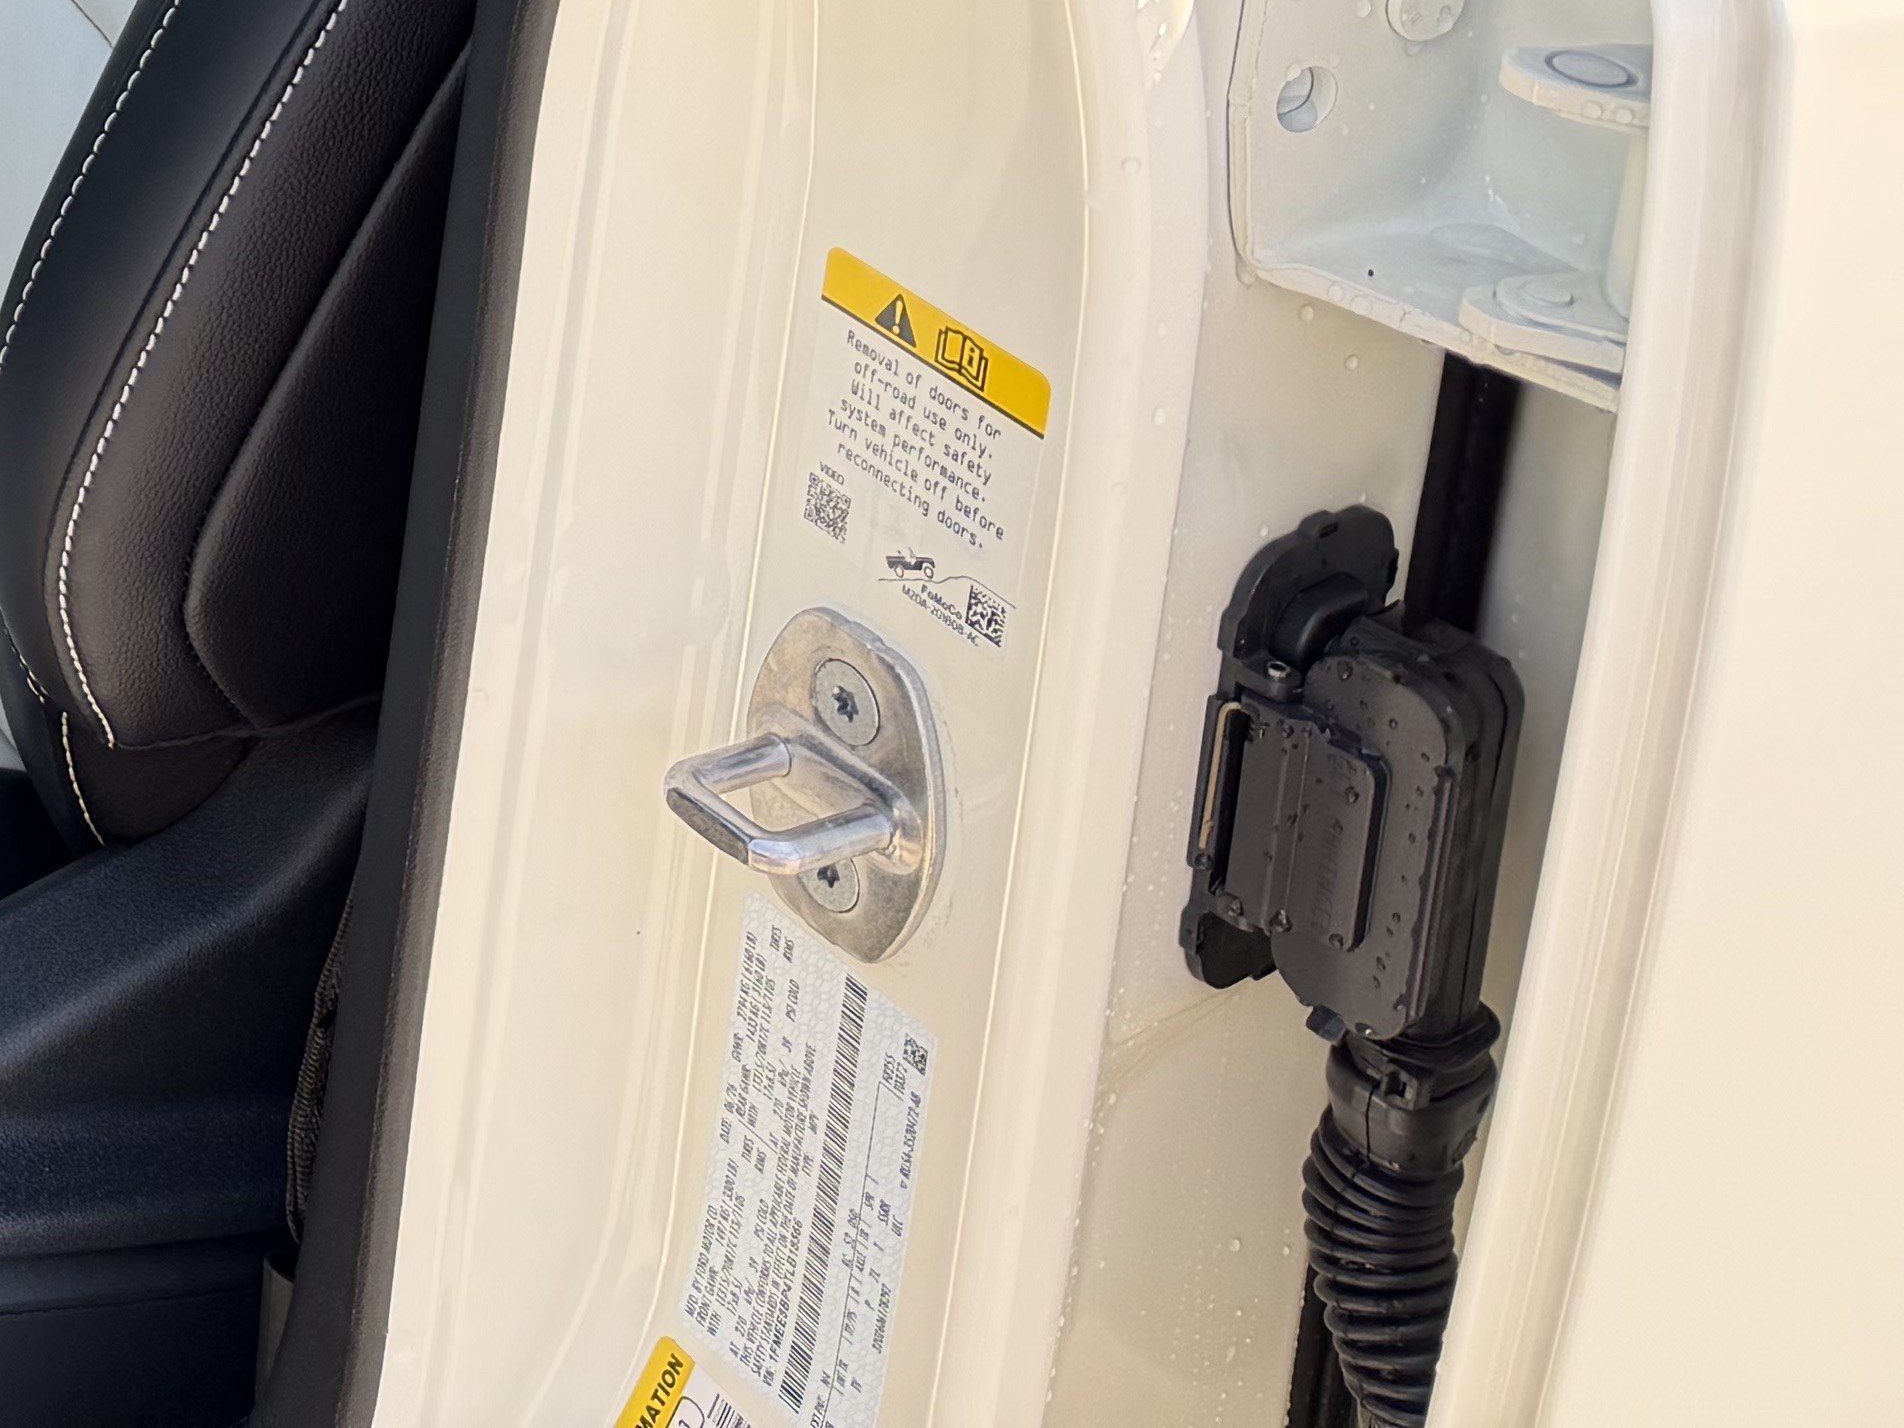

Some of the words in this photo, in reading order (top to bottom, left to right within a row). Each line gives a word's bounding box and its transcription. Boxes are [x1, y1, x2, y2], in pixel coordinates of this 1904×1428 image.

[847, 329, 899, 377] Removal
[906, 371, 922, 389] of
[929, 385, 969, 421] doors
[978, 415, 1002, 440] for
[851, 378, 881, 411] Will
[889, 408, 936, 446] affect
[943, 443, 992, 486] safety
[854, 361, 916, 410] off-road
[923, 406, 947, 431] use
[954, 427, 993, 459] only.
[819, 461, 845, 485] VIDEO
[828, 408, 857, 441] Turn
[865, 437, 919, 483] vehicle
[924, 478, 948, 500] off
[955, 495, 1004, 541] before
[837, 443, 930, 518] reconnecting
[937, 510, 983, 549] doors.
[841, 398, 886, 438] system
[892, 433, 986, 503] performance.
[921, 583, 962, 620] FoMoCo
[754, 1256, 771, 1309] CONFORMS
[782, 1102, 796, 1138] MOTOR
[695, 1292, 711, 1329] FRONT
